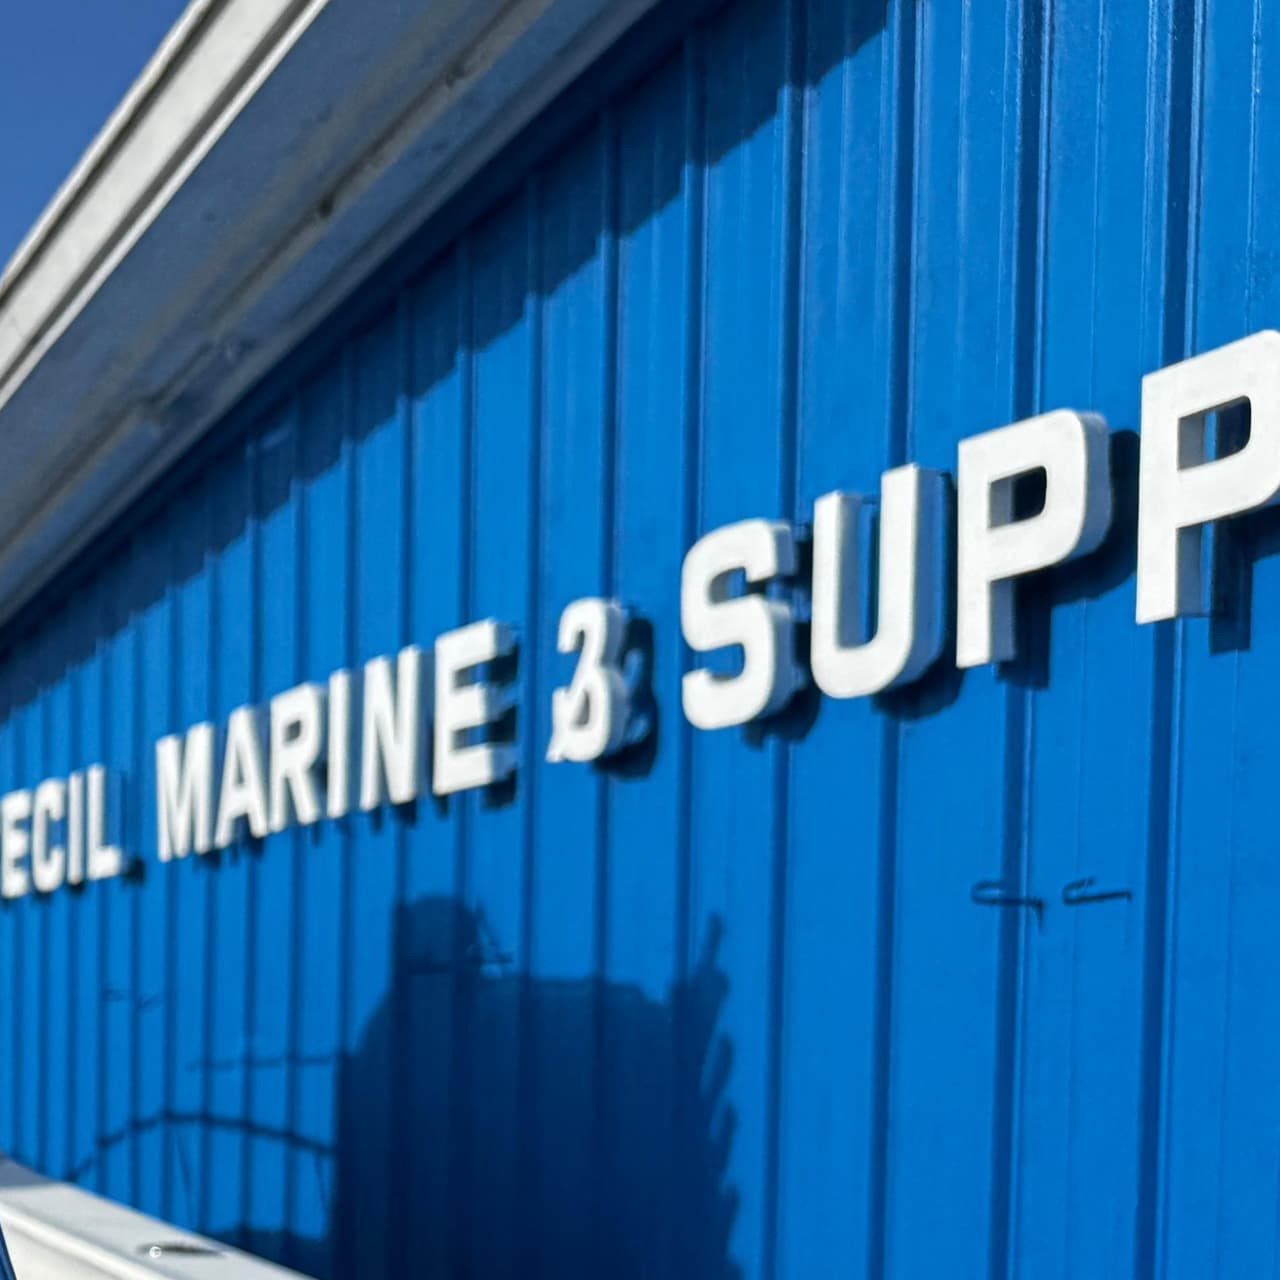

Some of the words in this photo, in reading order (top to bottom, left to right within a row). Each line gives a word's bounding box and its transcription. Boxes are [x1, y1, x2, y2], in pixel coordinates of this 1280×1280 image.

[155, 617, 518, 862] MARINE
[547, 596, 636, 763] &
[680, 328, 1280, 730] SUPP
